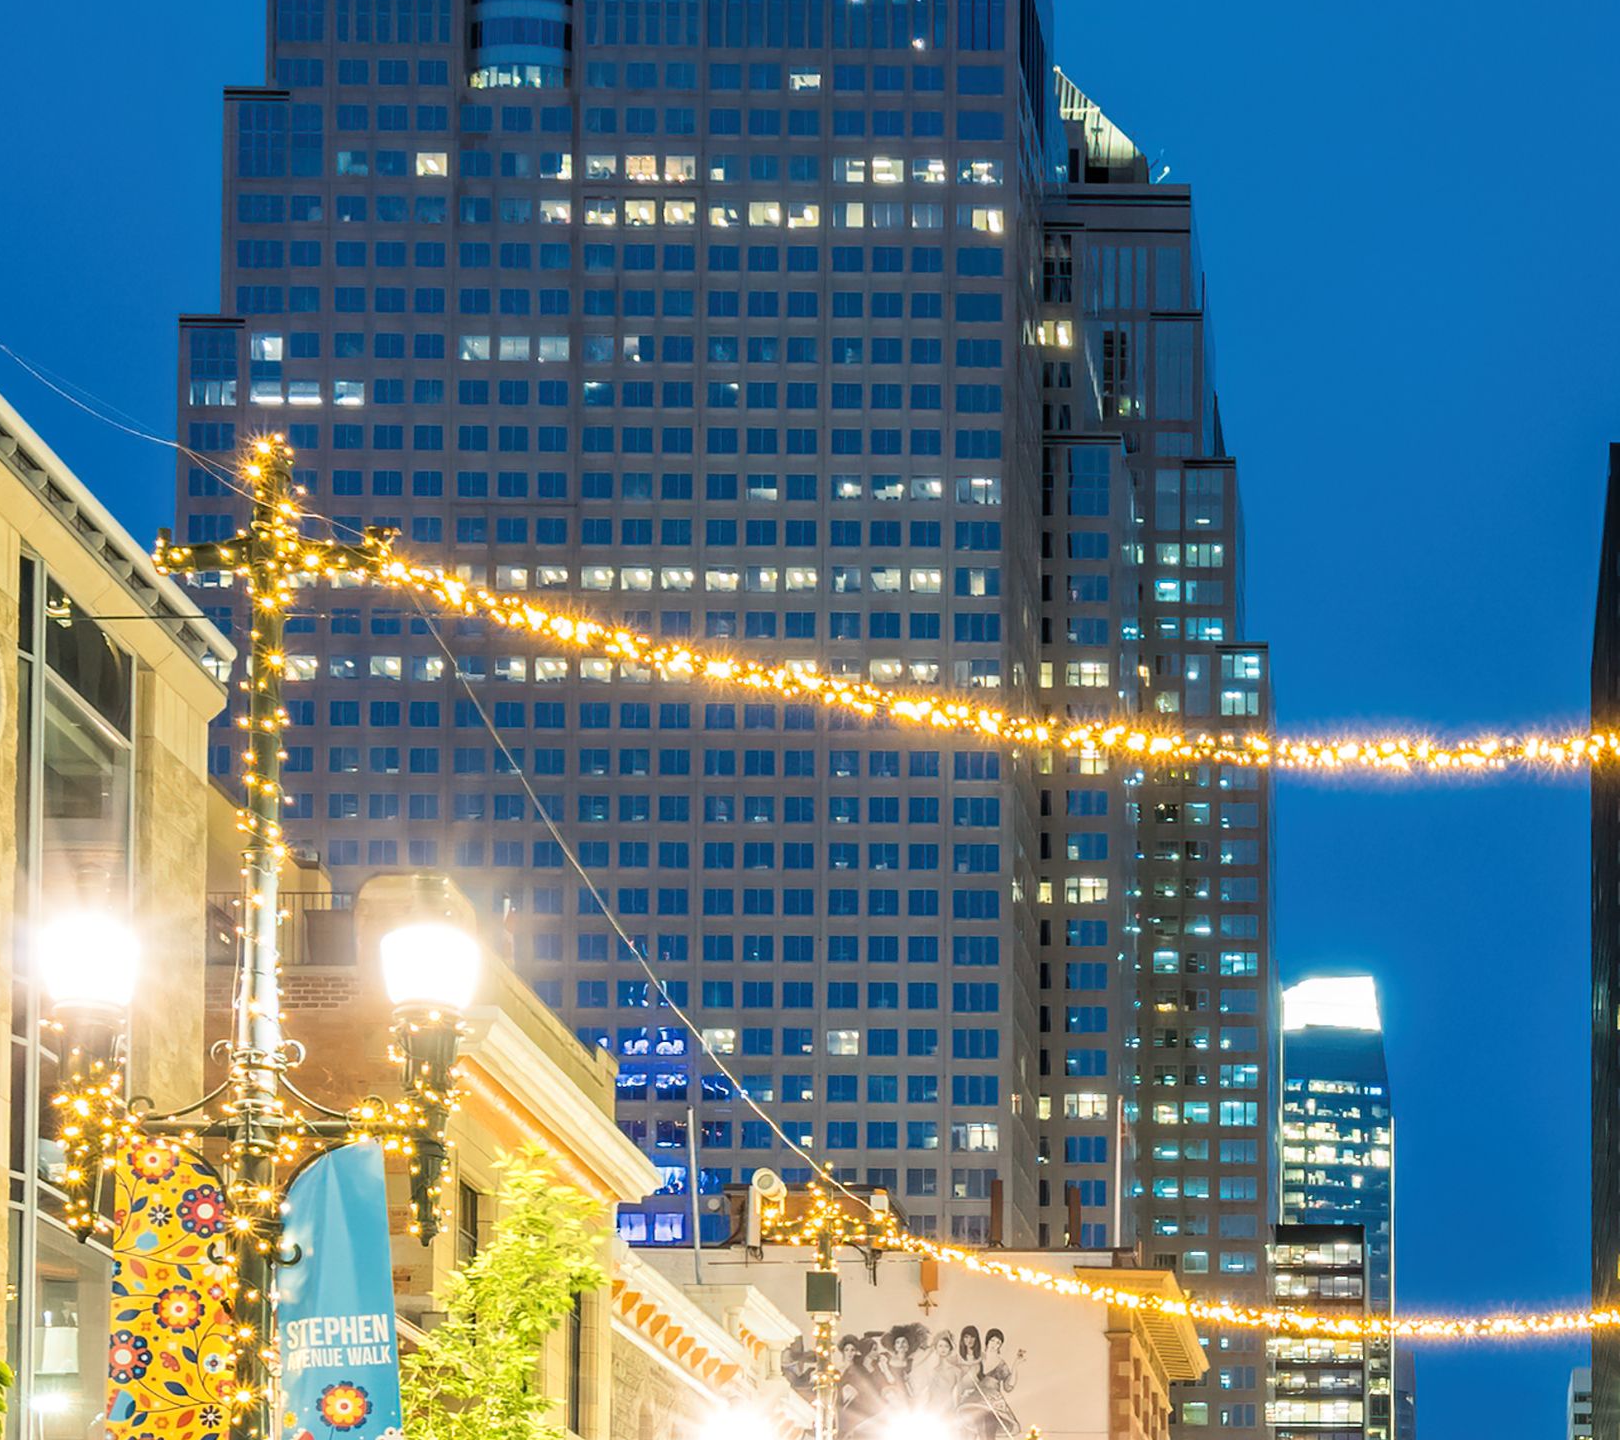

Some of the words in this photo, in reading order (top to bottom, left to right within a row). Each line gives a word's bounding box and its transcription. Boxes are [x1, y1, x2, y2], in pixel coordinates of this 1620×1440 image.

[285, 1313, 390, 1350] STEPHEN
[287, 1347, 344, 1371] AVENUE
[347, 1344, 392, 1367] WALK
